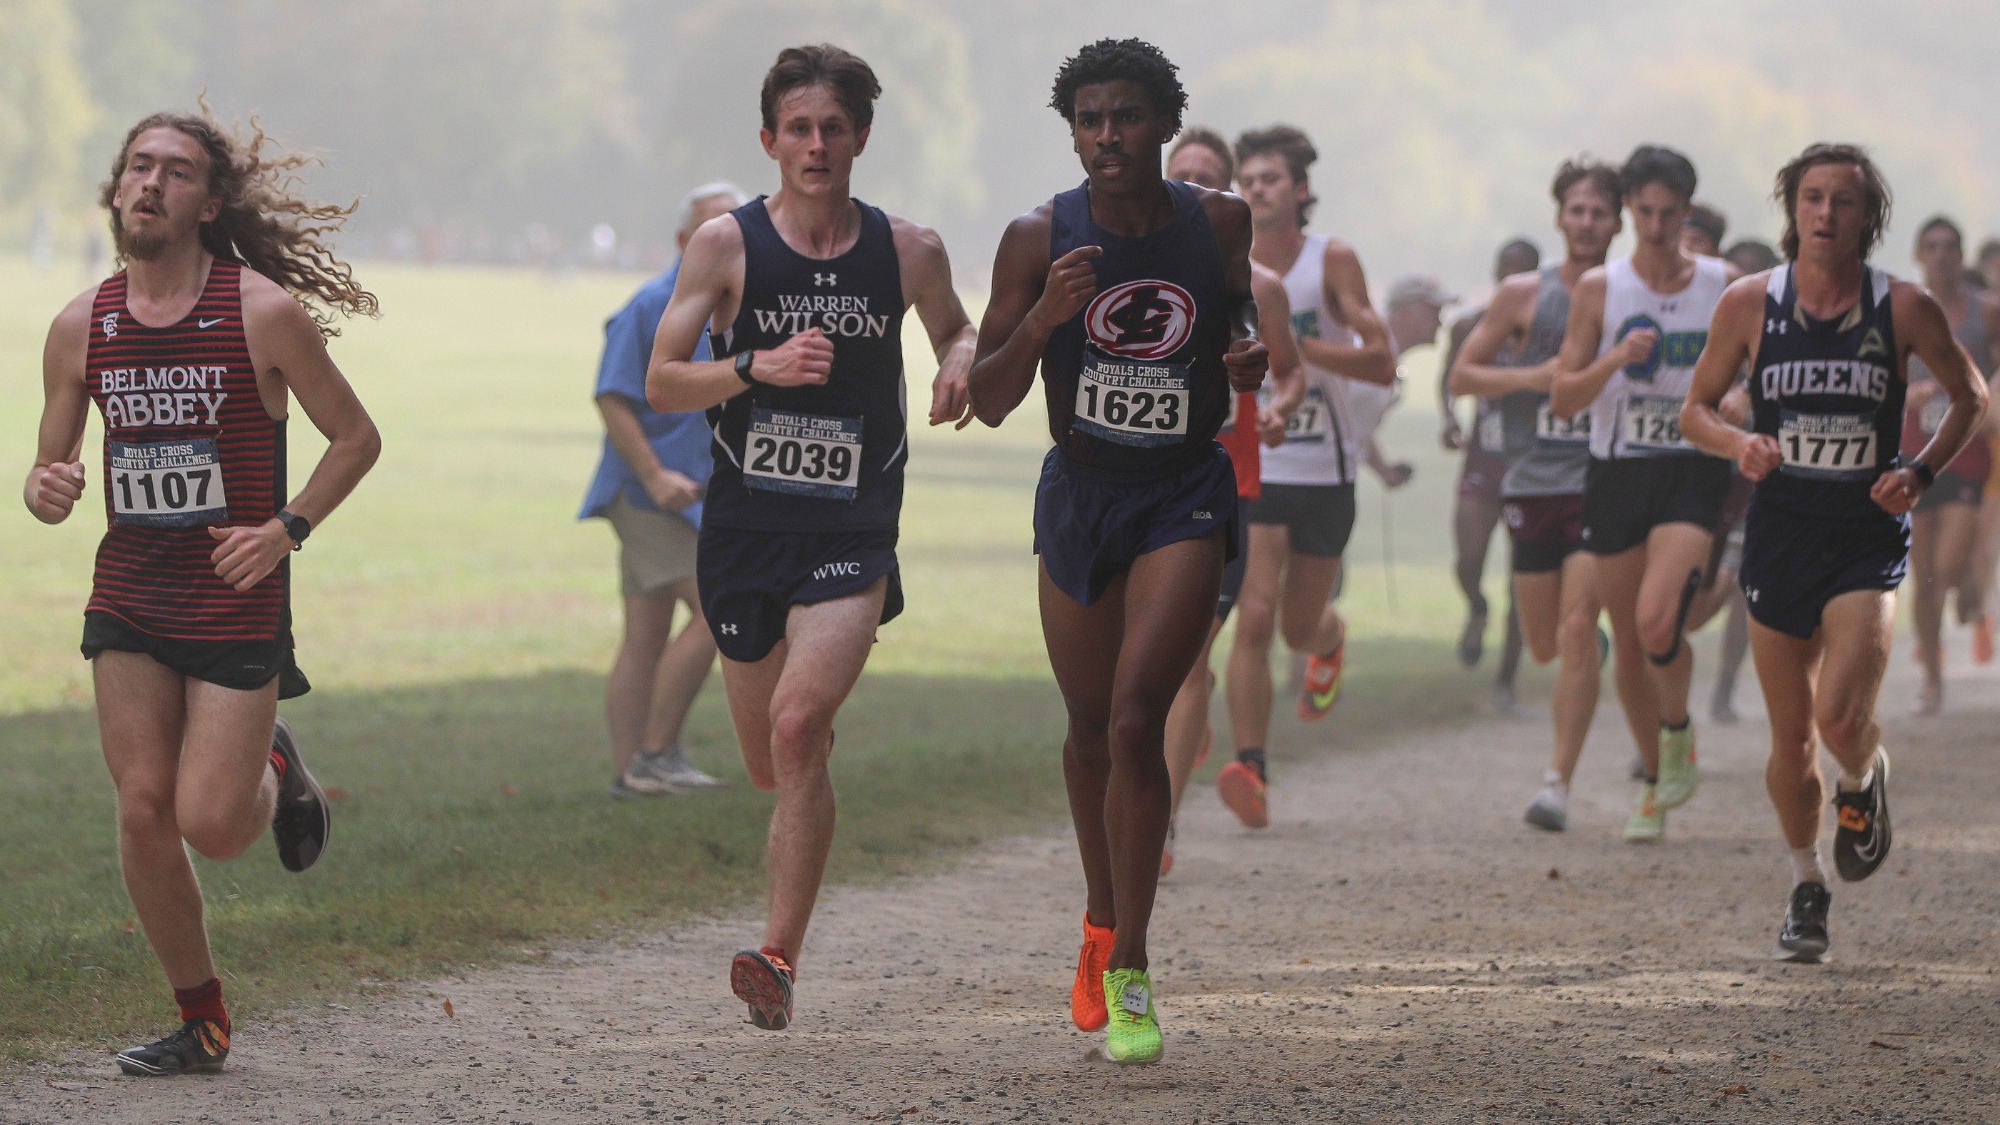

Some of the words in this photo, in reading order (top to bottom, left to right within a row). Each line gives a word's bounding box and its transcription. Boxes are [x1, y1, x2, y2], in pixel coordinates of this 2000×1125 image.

[778, 295, 868, 313] WARREN
[754, 309, 889, 338] WILSON
[100, 366, 227, 394] BELMONT
[1083, 366, 1126, 387] COUNTRY
[1128, 376, 1185, 389] CHALLENGE
[1097, 362, 1134, 376] ROYALS
[1137, 366, 1170, 378] CROSS
[1761, 359, 1889, 403] QUEENS
[105, 392, 228, 429] ABBEY
[1084, 384, 1179, 430] 1623
[753, 422, 798, 437] COUNTRY
[801, 428, 857, 443] CHALLENGE
[771, 414, 808, 427] ROYALS
[810, 418, 842, 431] CROSS
[112, 457, 150, 469] COUNTRY
[154, 454, 212, 468] CHALLENGE
[123, 446, 157, 458] ROYALS
[160, 444, 194, 457] CROSS
[751, 437, 852, 482] 2039
[1786, 435, 1870, 466] 1777
[117, 469, 212, 510] 1107
[813, 562, 861, 581] WWC
